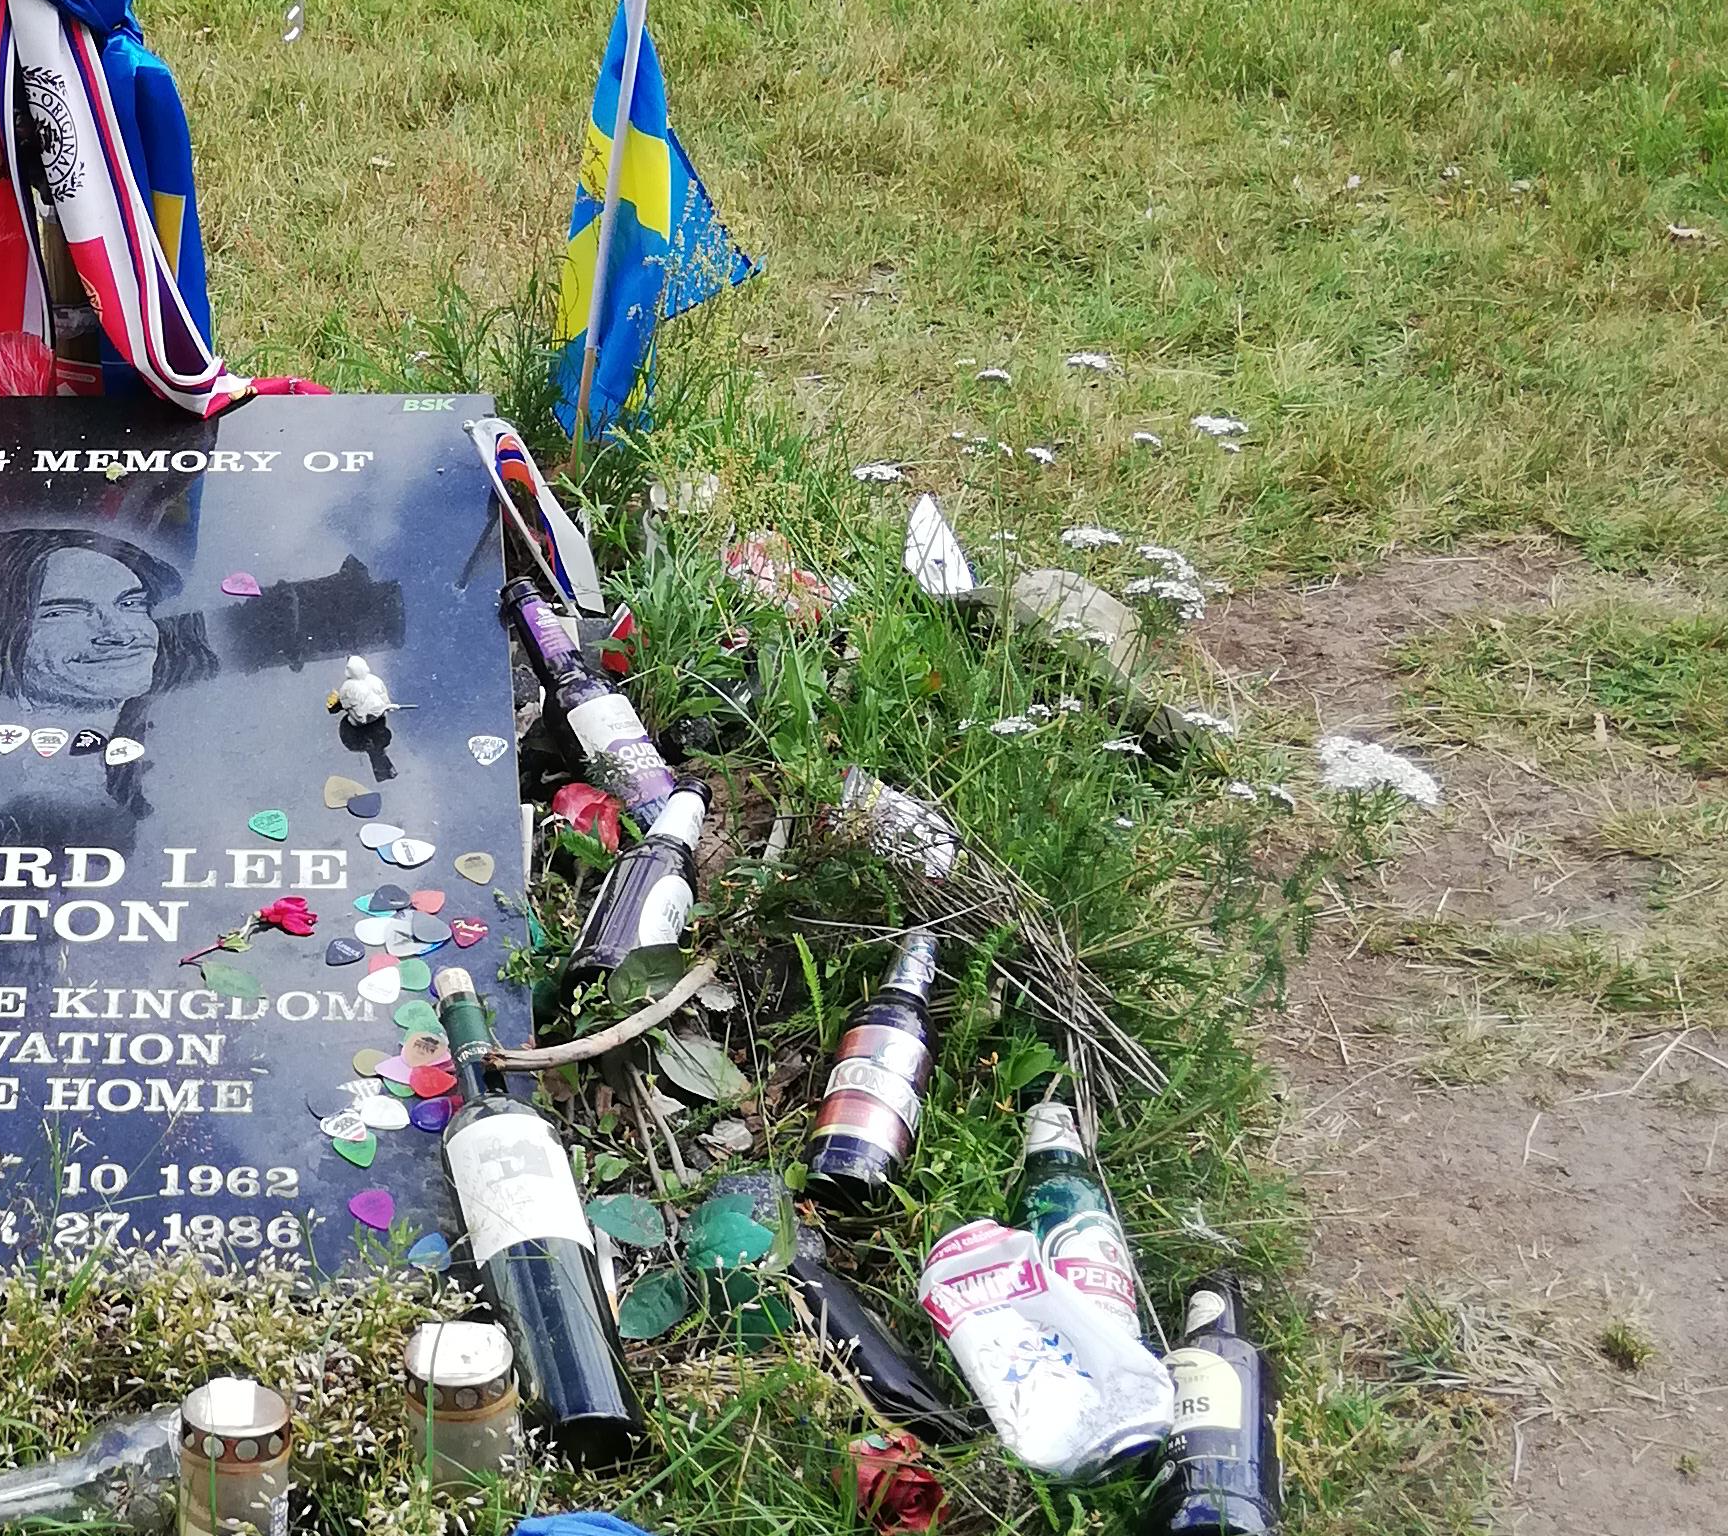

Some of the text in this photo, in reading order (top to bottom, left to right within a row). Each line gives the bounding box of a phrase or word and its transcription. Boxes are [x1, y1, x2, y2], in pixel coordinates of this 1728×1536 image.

[402, 398, 457, 413] BSK
[31, 448, 282, 474] MEMORY
[302, 449, 375, 474] OF
[150, 846, 349, 890] LEE
[49, 985, 378, 1023] KINGDOM
[42, 1076, 254, 1114] HOME
[61, 1163, 128, 1197] 10
[159, 1164, 300, 1199] 1962
[54, 1212, 122, 1248] 27
[161, 1212, 302, 1249] 1986
